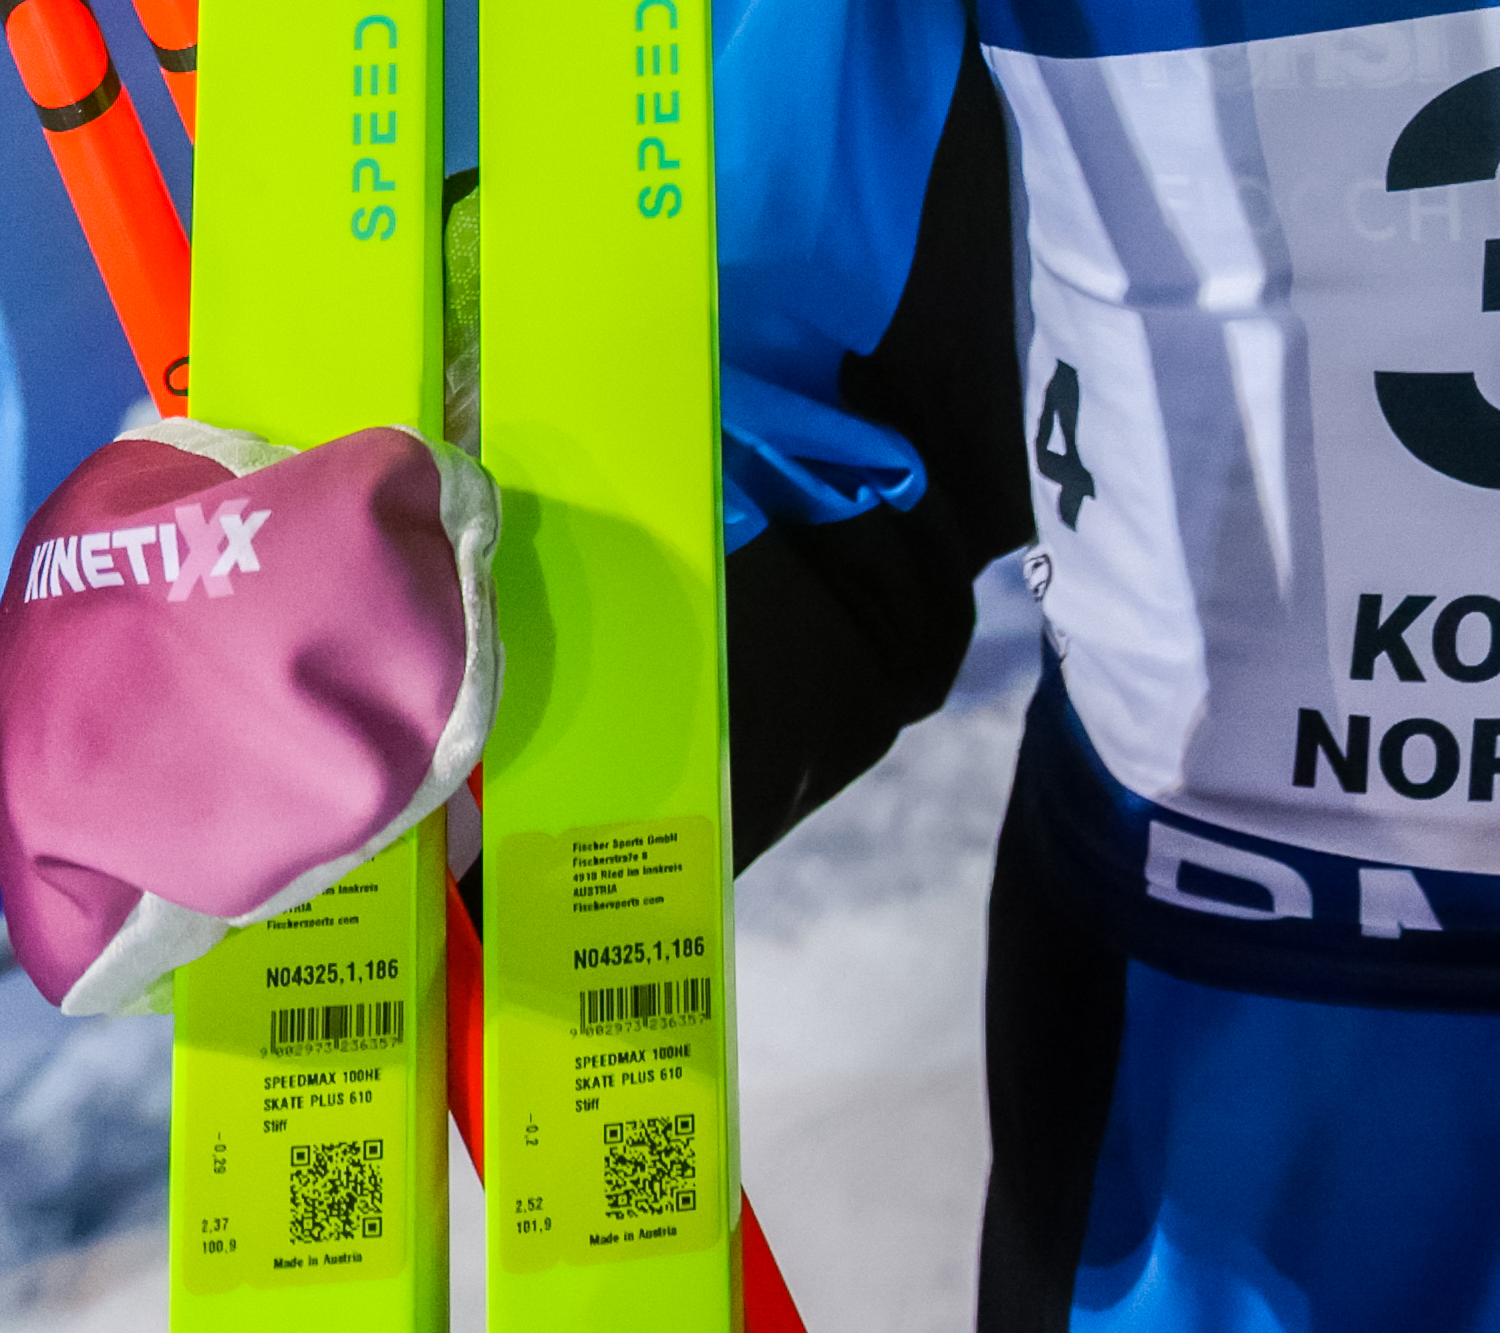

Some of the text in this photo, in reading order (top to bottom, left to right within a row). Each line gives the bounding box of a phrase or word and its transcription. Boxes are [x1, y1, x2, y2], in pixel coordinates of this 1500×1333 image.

[24, 497, 273, 604] KINETIXX
[574, 1049, 647, 1070] SPEEDMAX
[263, 1072, 337, 1090] SPEEDMAX
[575, 1066, 683, 1092] SKATE PLUS 610
[263, 1090, 373, 1112] SKATE PLUS 610
[575, 1097, 600, 1113] Stiff
[263, 1119, 288, 1134] Stiff
[589, 1232, 620, 1247] Made
[623, 1230, 635, 1241] in
[273, 1256, 304, 1270] Made
